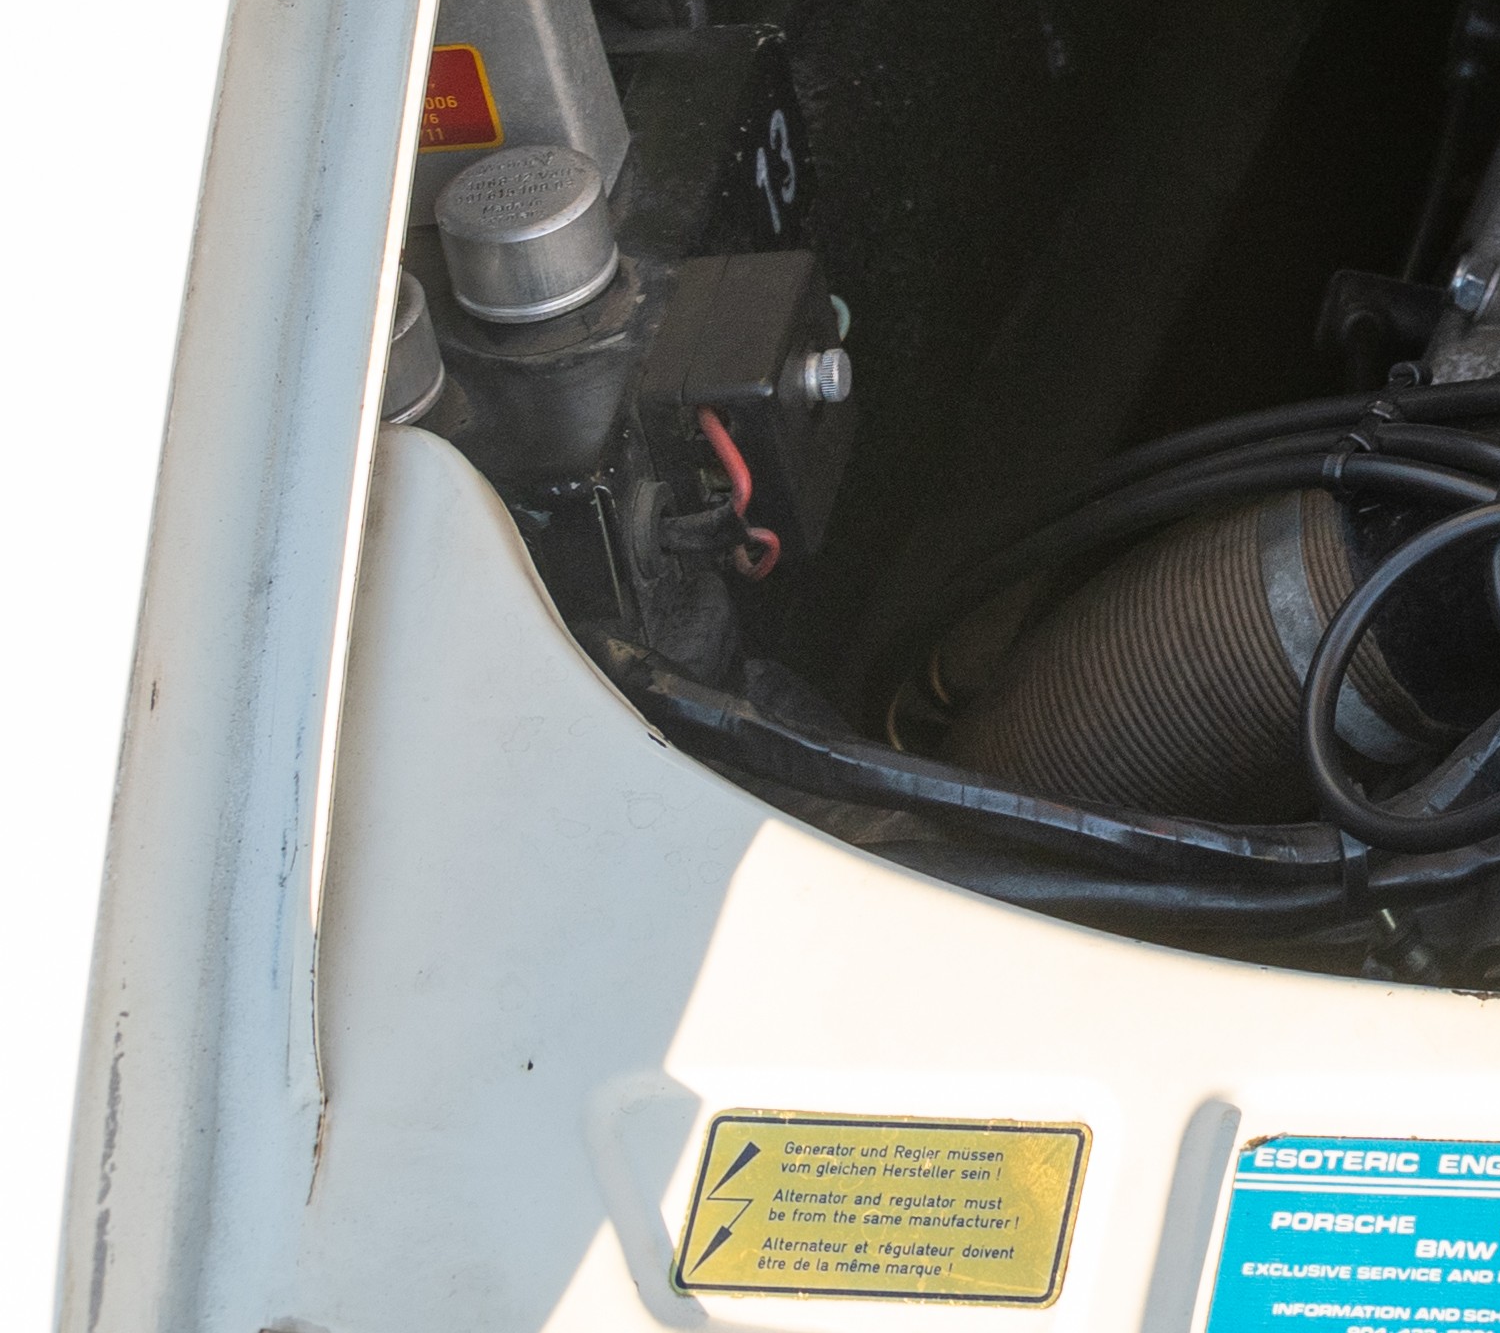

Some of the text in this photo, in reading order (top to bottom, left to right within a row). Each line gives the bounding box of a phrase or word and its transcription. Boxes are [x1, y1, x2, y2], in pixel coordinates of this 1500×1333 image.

[784, 1140, 1004, 1163] Generator und Regler müssen
[1254, 1147, 1420, 1174] ESOTERIC
[781, 1162, 811, 1174] vom
[815, 1161, 877, 1178] gleichen
[882, 1163, 956, 1180] Hersteller
[772, 1188, 1003, 1211] Alternator and regulator must
[768, 1207, 786, 1222] be
[792, 1208, 827, 1223] from
[833, 1209, 857, 1224] the
[862, 1214, 903, 1226] same
[1270, 1211, 1416, 1235] PORSCHE
[761, 1236, 1015, 1260] Alternateur et régulateur doivent
[1415, 1239, 1498, 1261] BMW
[757, 1255, 787, 1270] être
[793, 1257, 811, 1271] de
[815, 1257, 829, 1272] la
[834, 1258, 881, 1274] même
[1241, 1262, 1352, 1280] EXCLUSIVE
[1356, 1266, 1443, 1283] SERVICE
[1447, 1268, 1494, 1284] AND
[1271, 1302, 1411, 1321] INFORMATION
[1414, 1307, 1461, 1322] AND
